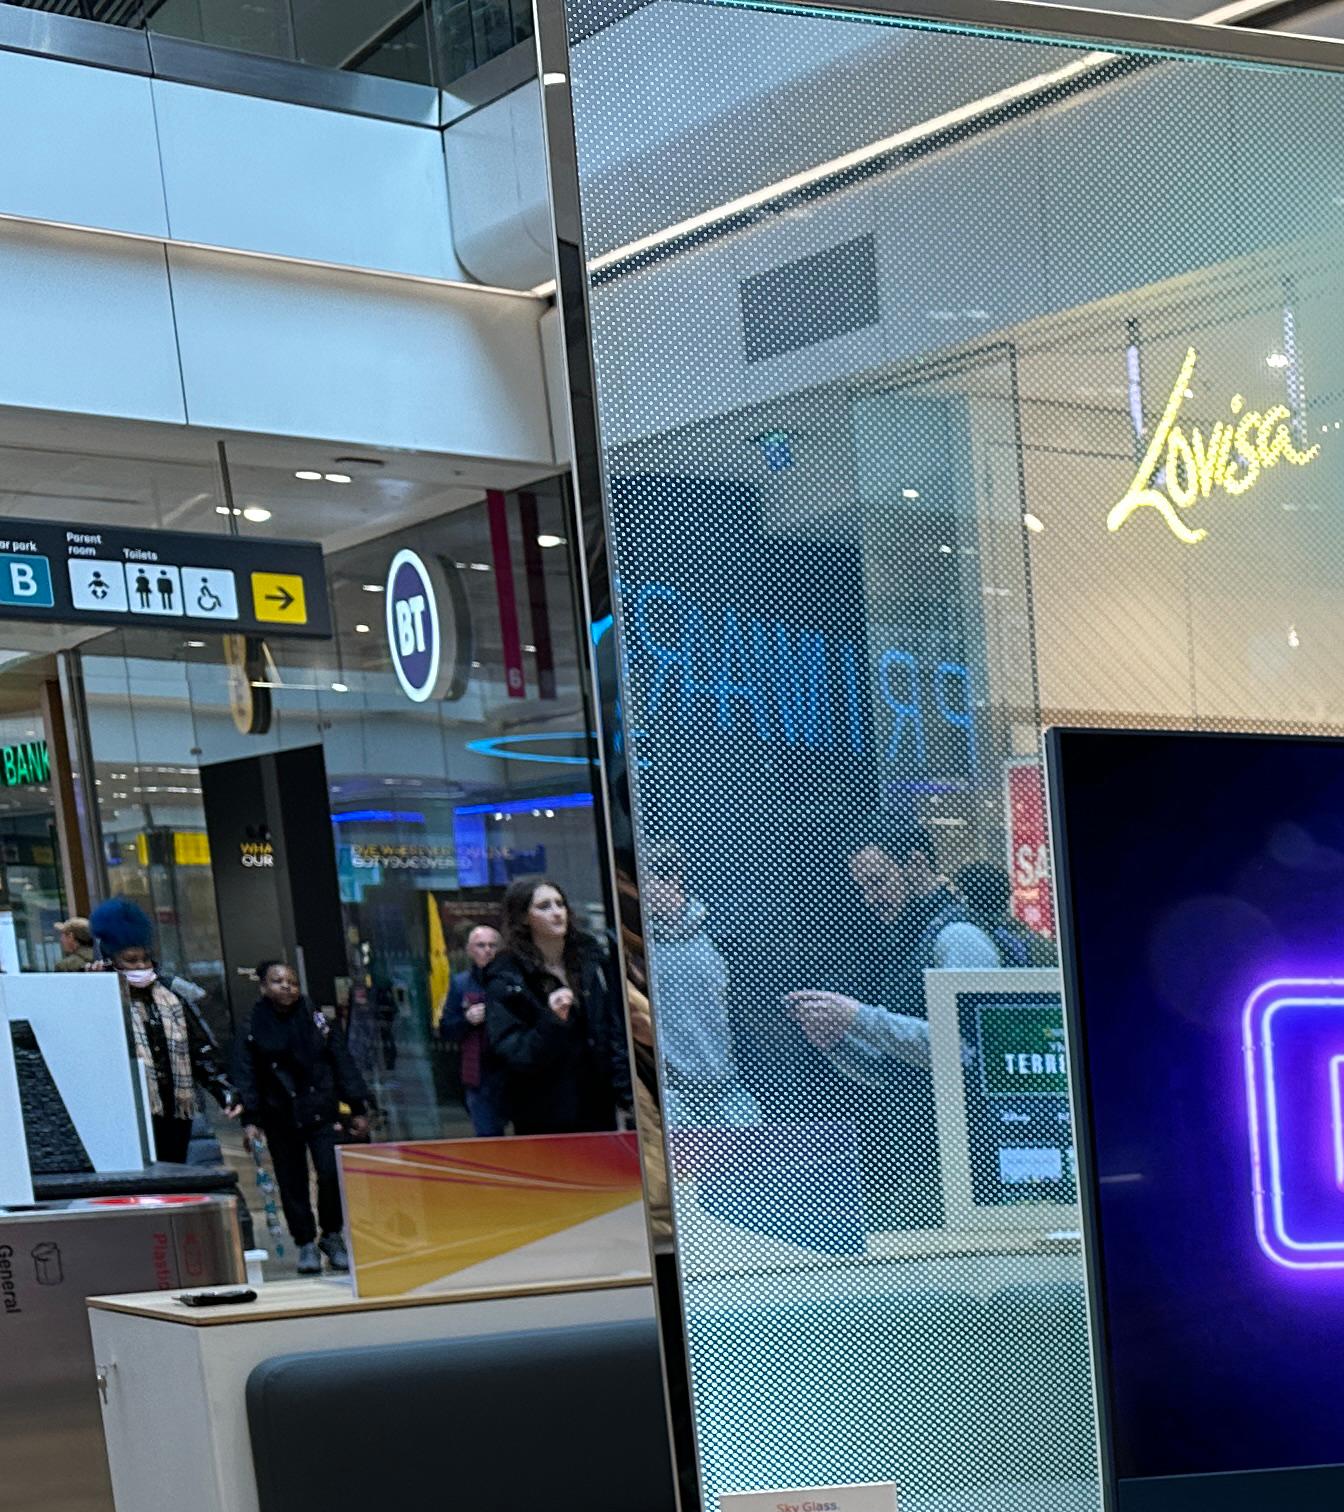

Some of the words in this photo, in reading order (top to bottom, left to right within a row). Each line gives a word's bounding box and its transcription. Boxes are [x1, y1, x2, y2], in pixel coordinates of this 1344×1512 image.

[1106, 346, 1321, 544] Lovisa
[12, 540, 38, 553] park
[66, 531, 103, 545] Parent
[68, 545, 96, 556] room
[123, 548, 158, 561] Toilets
[9, 562, 38, 597] B
[394, 595, 427, 658] BT
[2, 740, 50, 787] BANK
[0, 1244, 22, 1315] General
[802, 1501, 840, 1512] Glass.
